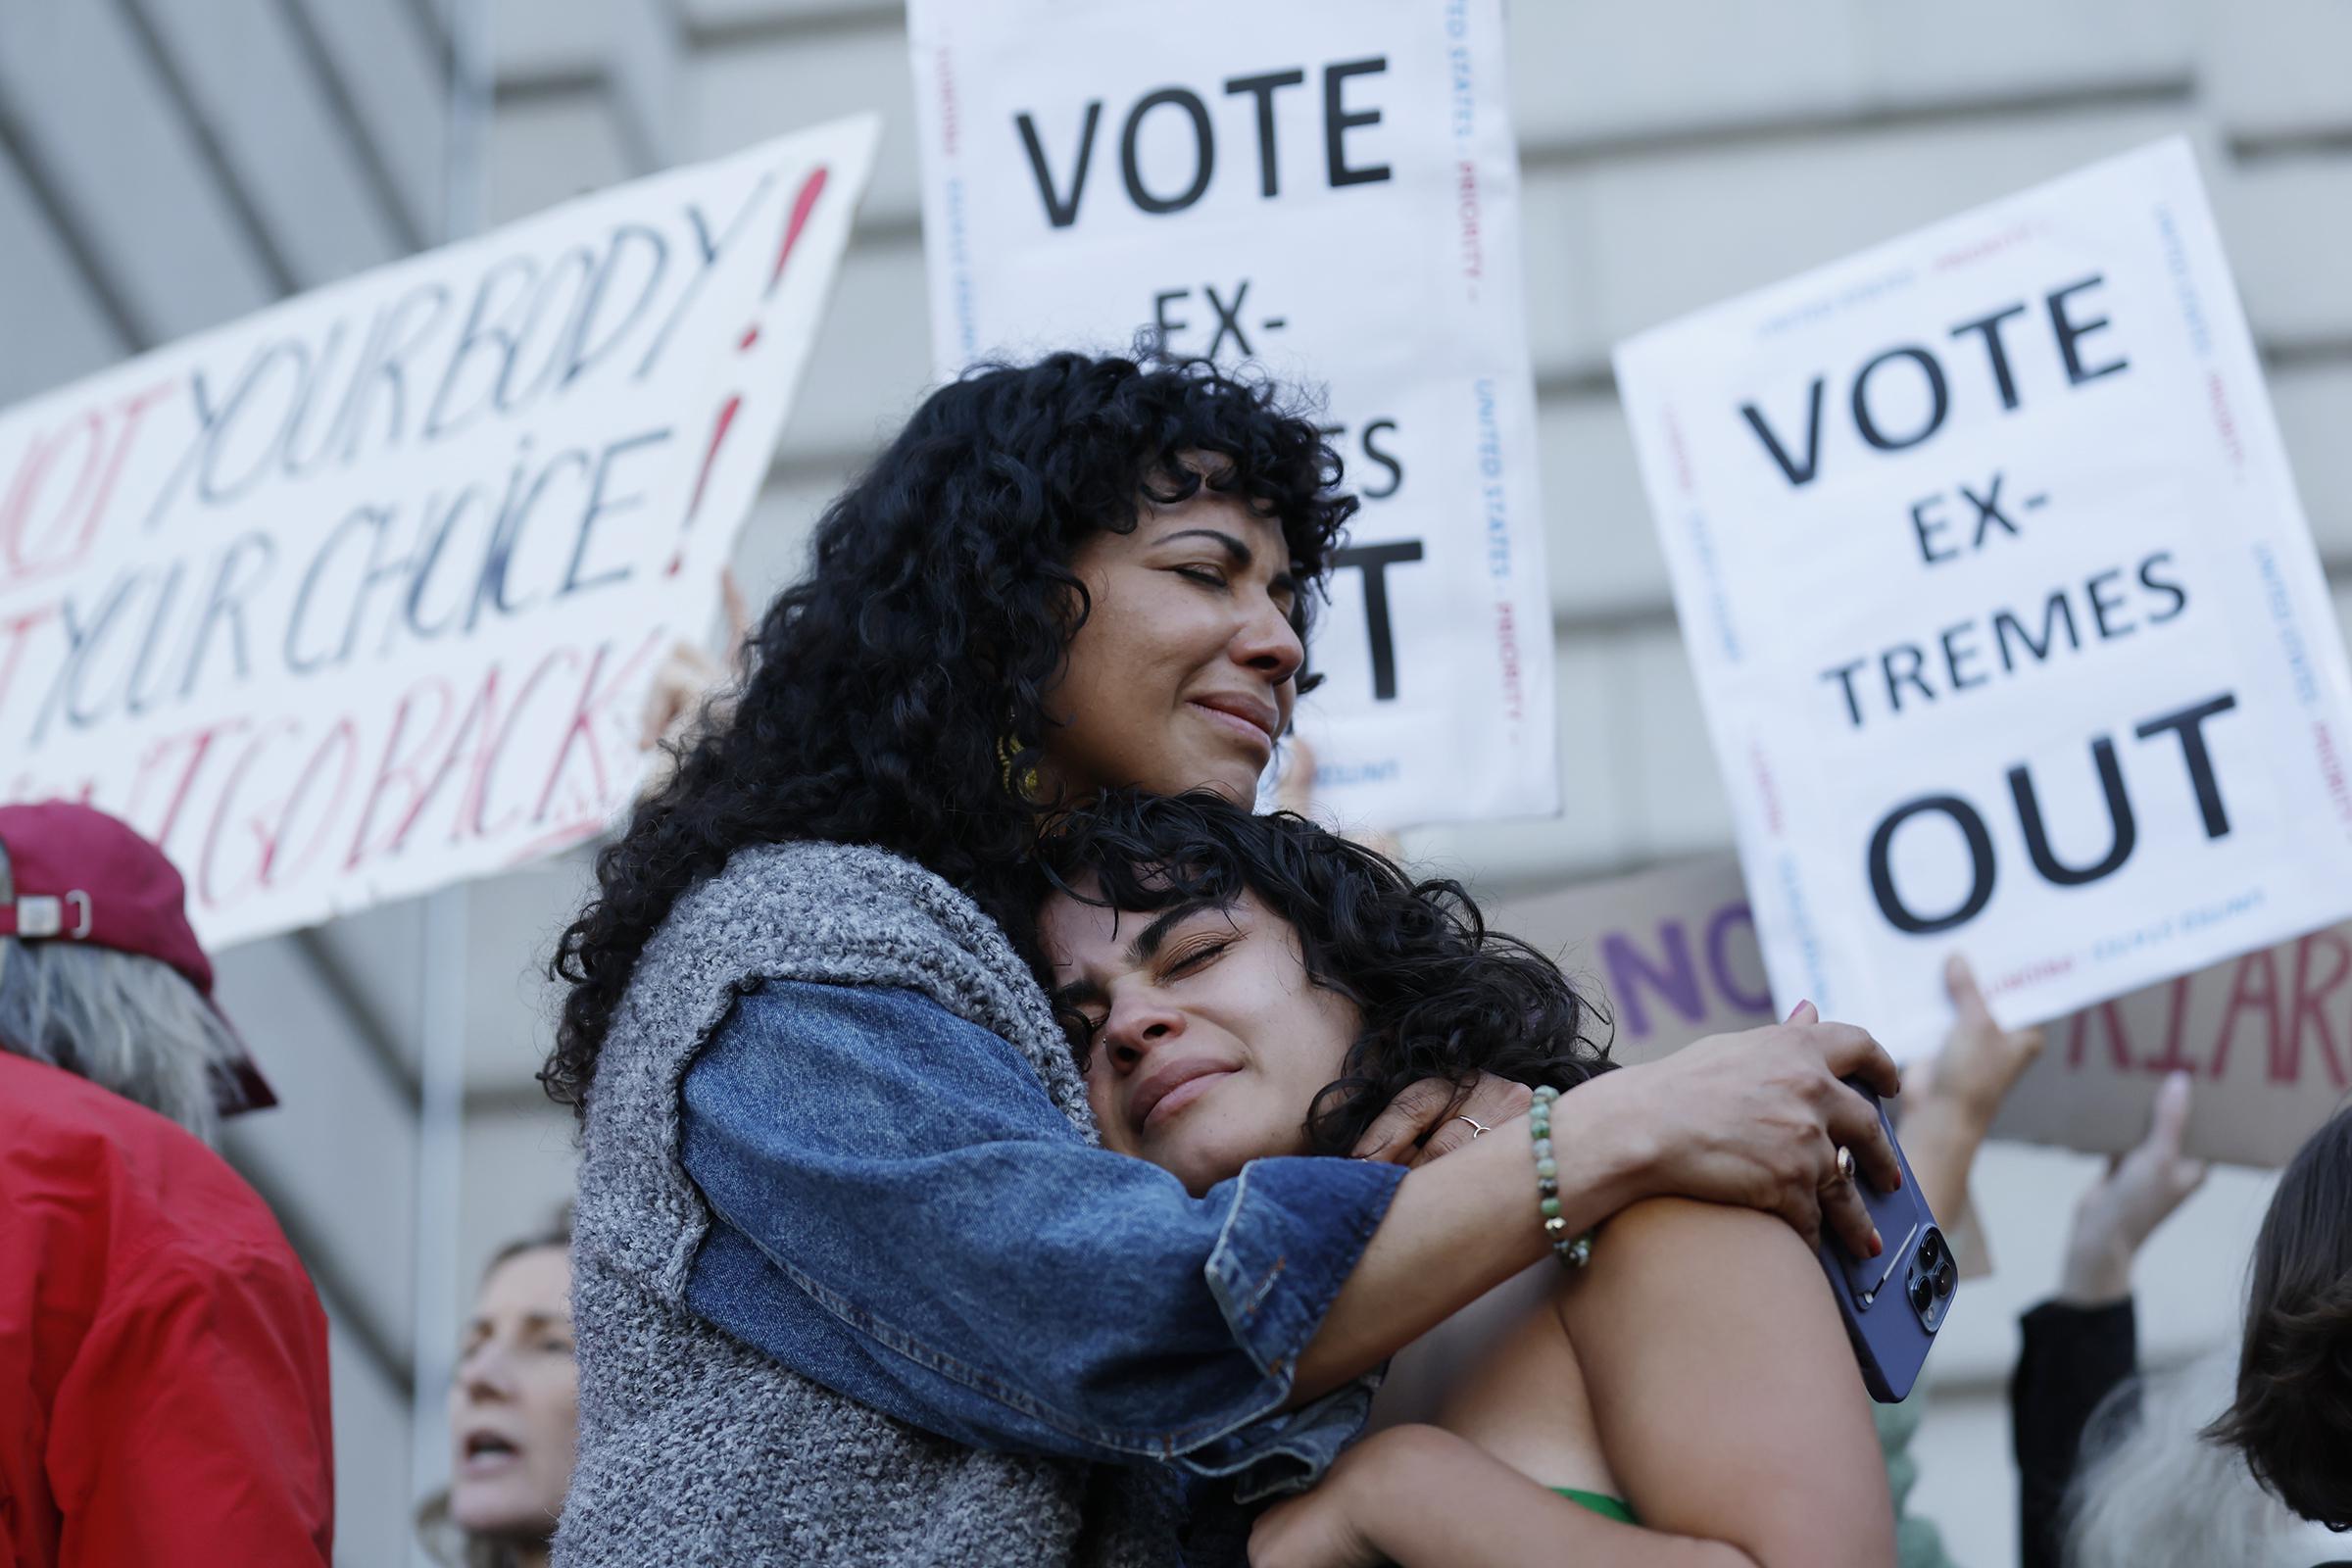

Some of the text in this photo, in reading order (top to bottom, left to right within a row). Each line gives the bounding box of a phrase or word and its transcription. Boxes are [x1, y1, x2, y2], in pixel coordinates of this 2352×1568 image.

[1014, 56, 1393, 229] VOTE
[1457, 160, 1483, 279] PRIORITY
[0, 377, 179, 585] OT
[142, 286, 454, 531] YOUR
[1740, 273, 2130, 487] VOTE
[1474, 378, 1525, 721] UNITED STATES PRIORITY
[1908, 471, 2050, 564] EX-
[27, 529, 277, 750] YOUR
[343, 623, 666, 872] BACK
[1818, 551, 2190, 728] TREMES
[1867, 692, 2237, 936] OUT
